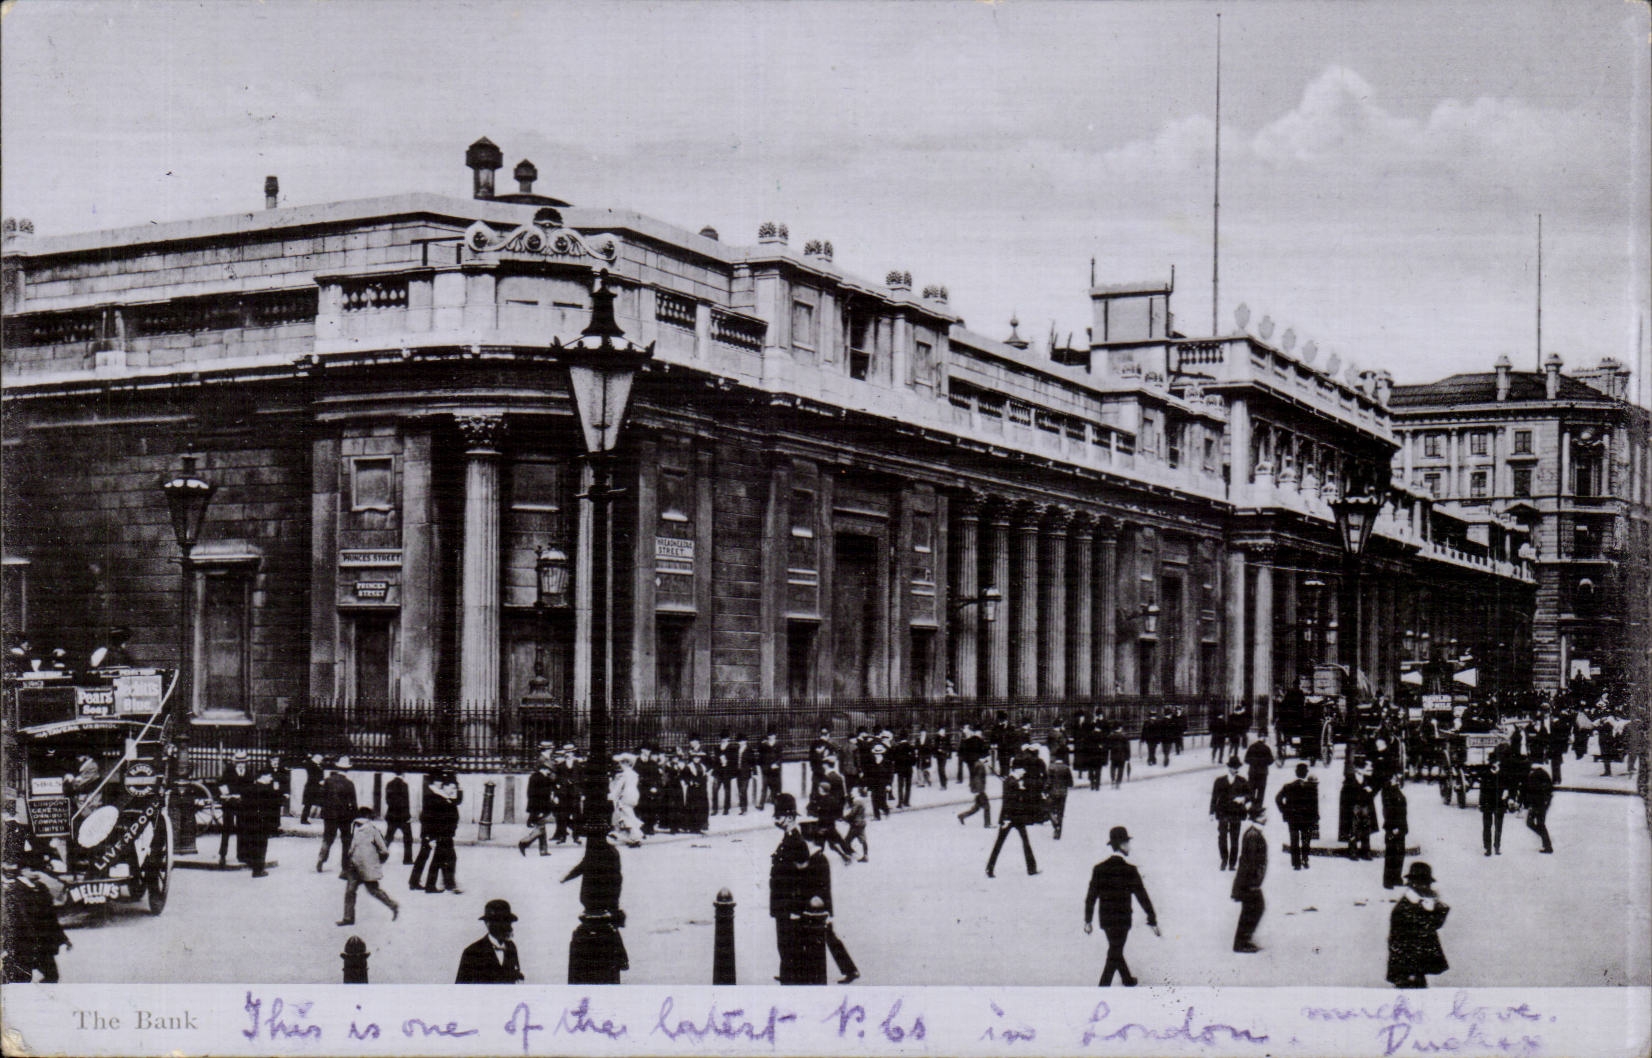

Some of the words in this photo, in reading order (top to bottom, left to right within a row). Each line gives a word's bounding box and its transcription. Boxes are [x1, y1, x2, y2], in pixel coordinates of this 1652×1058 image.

[373, 552, 401, 562] STREET
[1301, 995, 1424, 1023] much
[240, 991, 322, 1042] This
[348, 1005, 381, 1040] is
[402, 1018, 479, 1039] one
[504, 1002, 544, 1056] of
[553, 998, 628, 1039] the
[651, 997, 798, 1045] latest
[979, 1001, 1036, 1043] in
